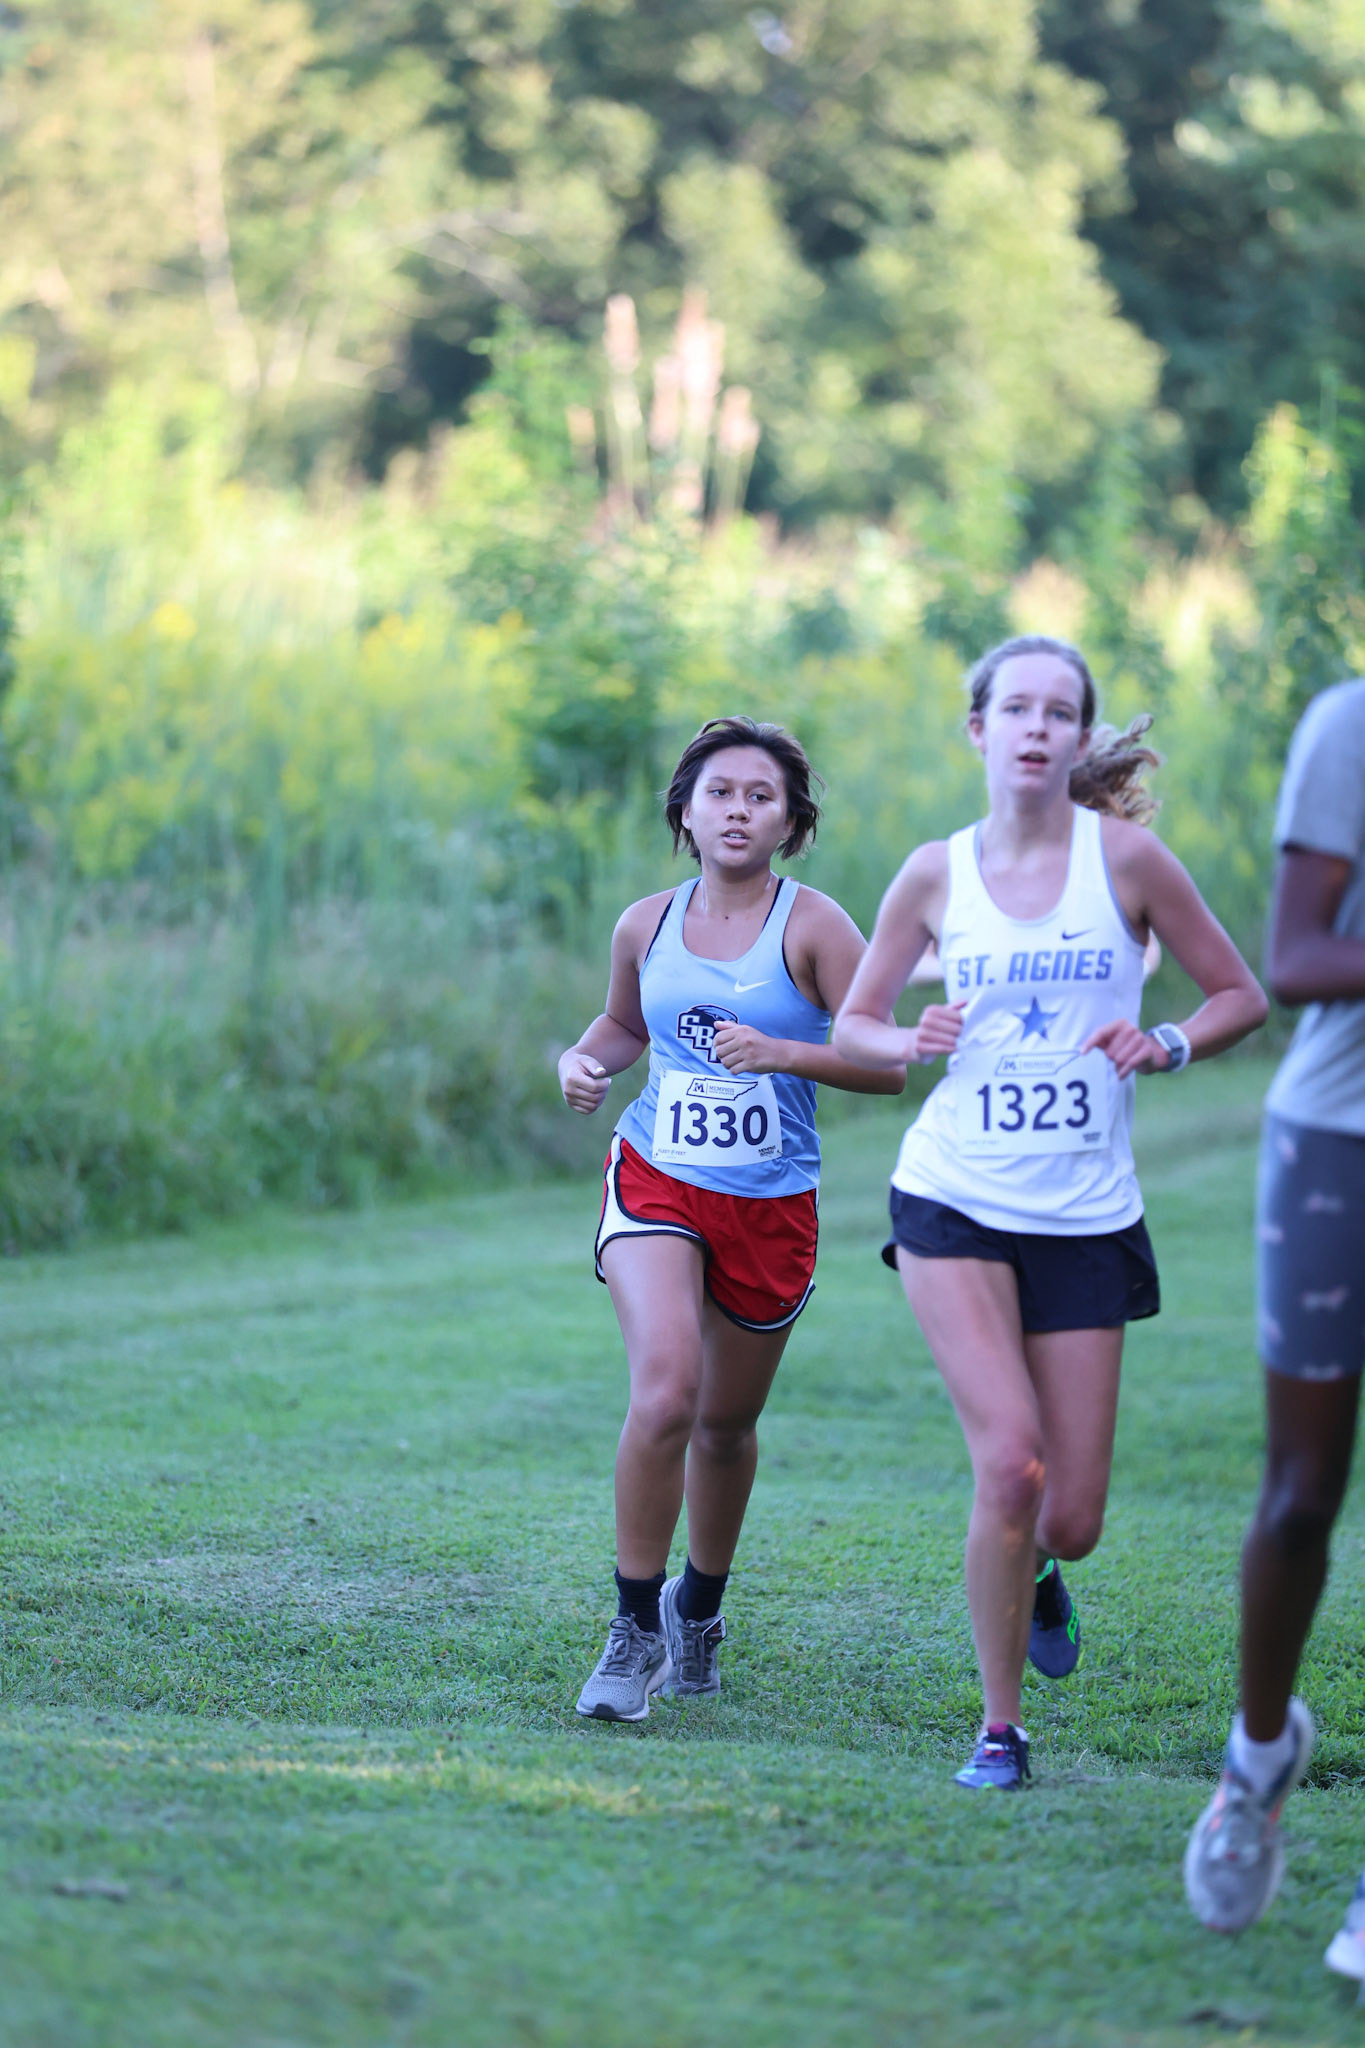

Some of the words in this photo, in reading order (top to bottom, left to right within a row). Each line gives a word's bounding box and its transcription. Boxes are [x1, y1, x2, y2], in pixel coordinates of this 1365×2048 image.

[958, 955, 995, 988] ST.
[1008, 949, 1113, 983] AGNES
[670, 1101, 768, 1148] 1330
[977, 1080, 1091, 1132] 1323
